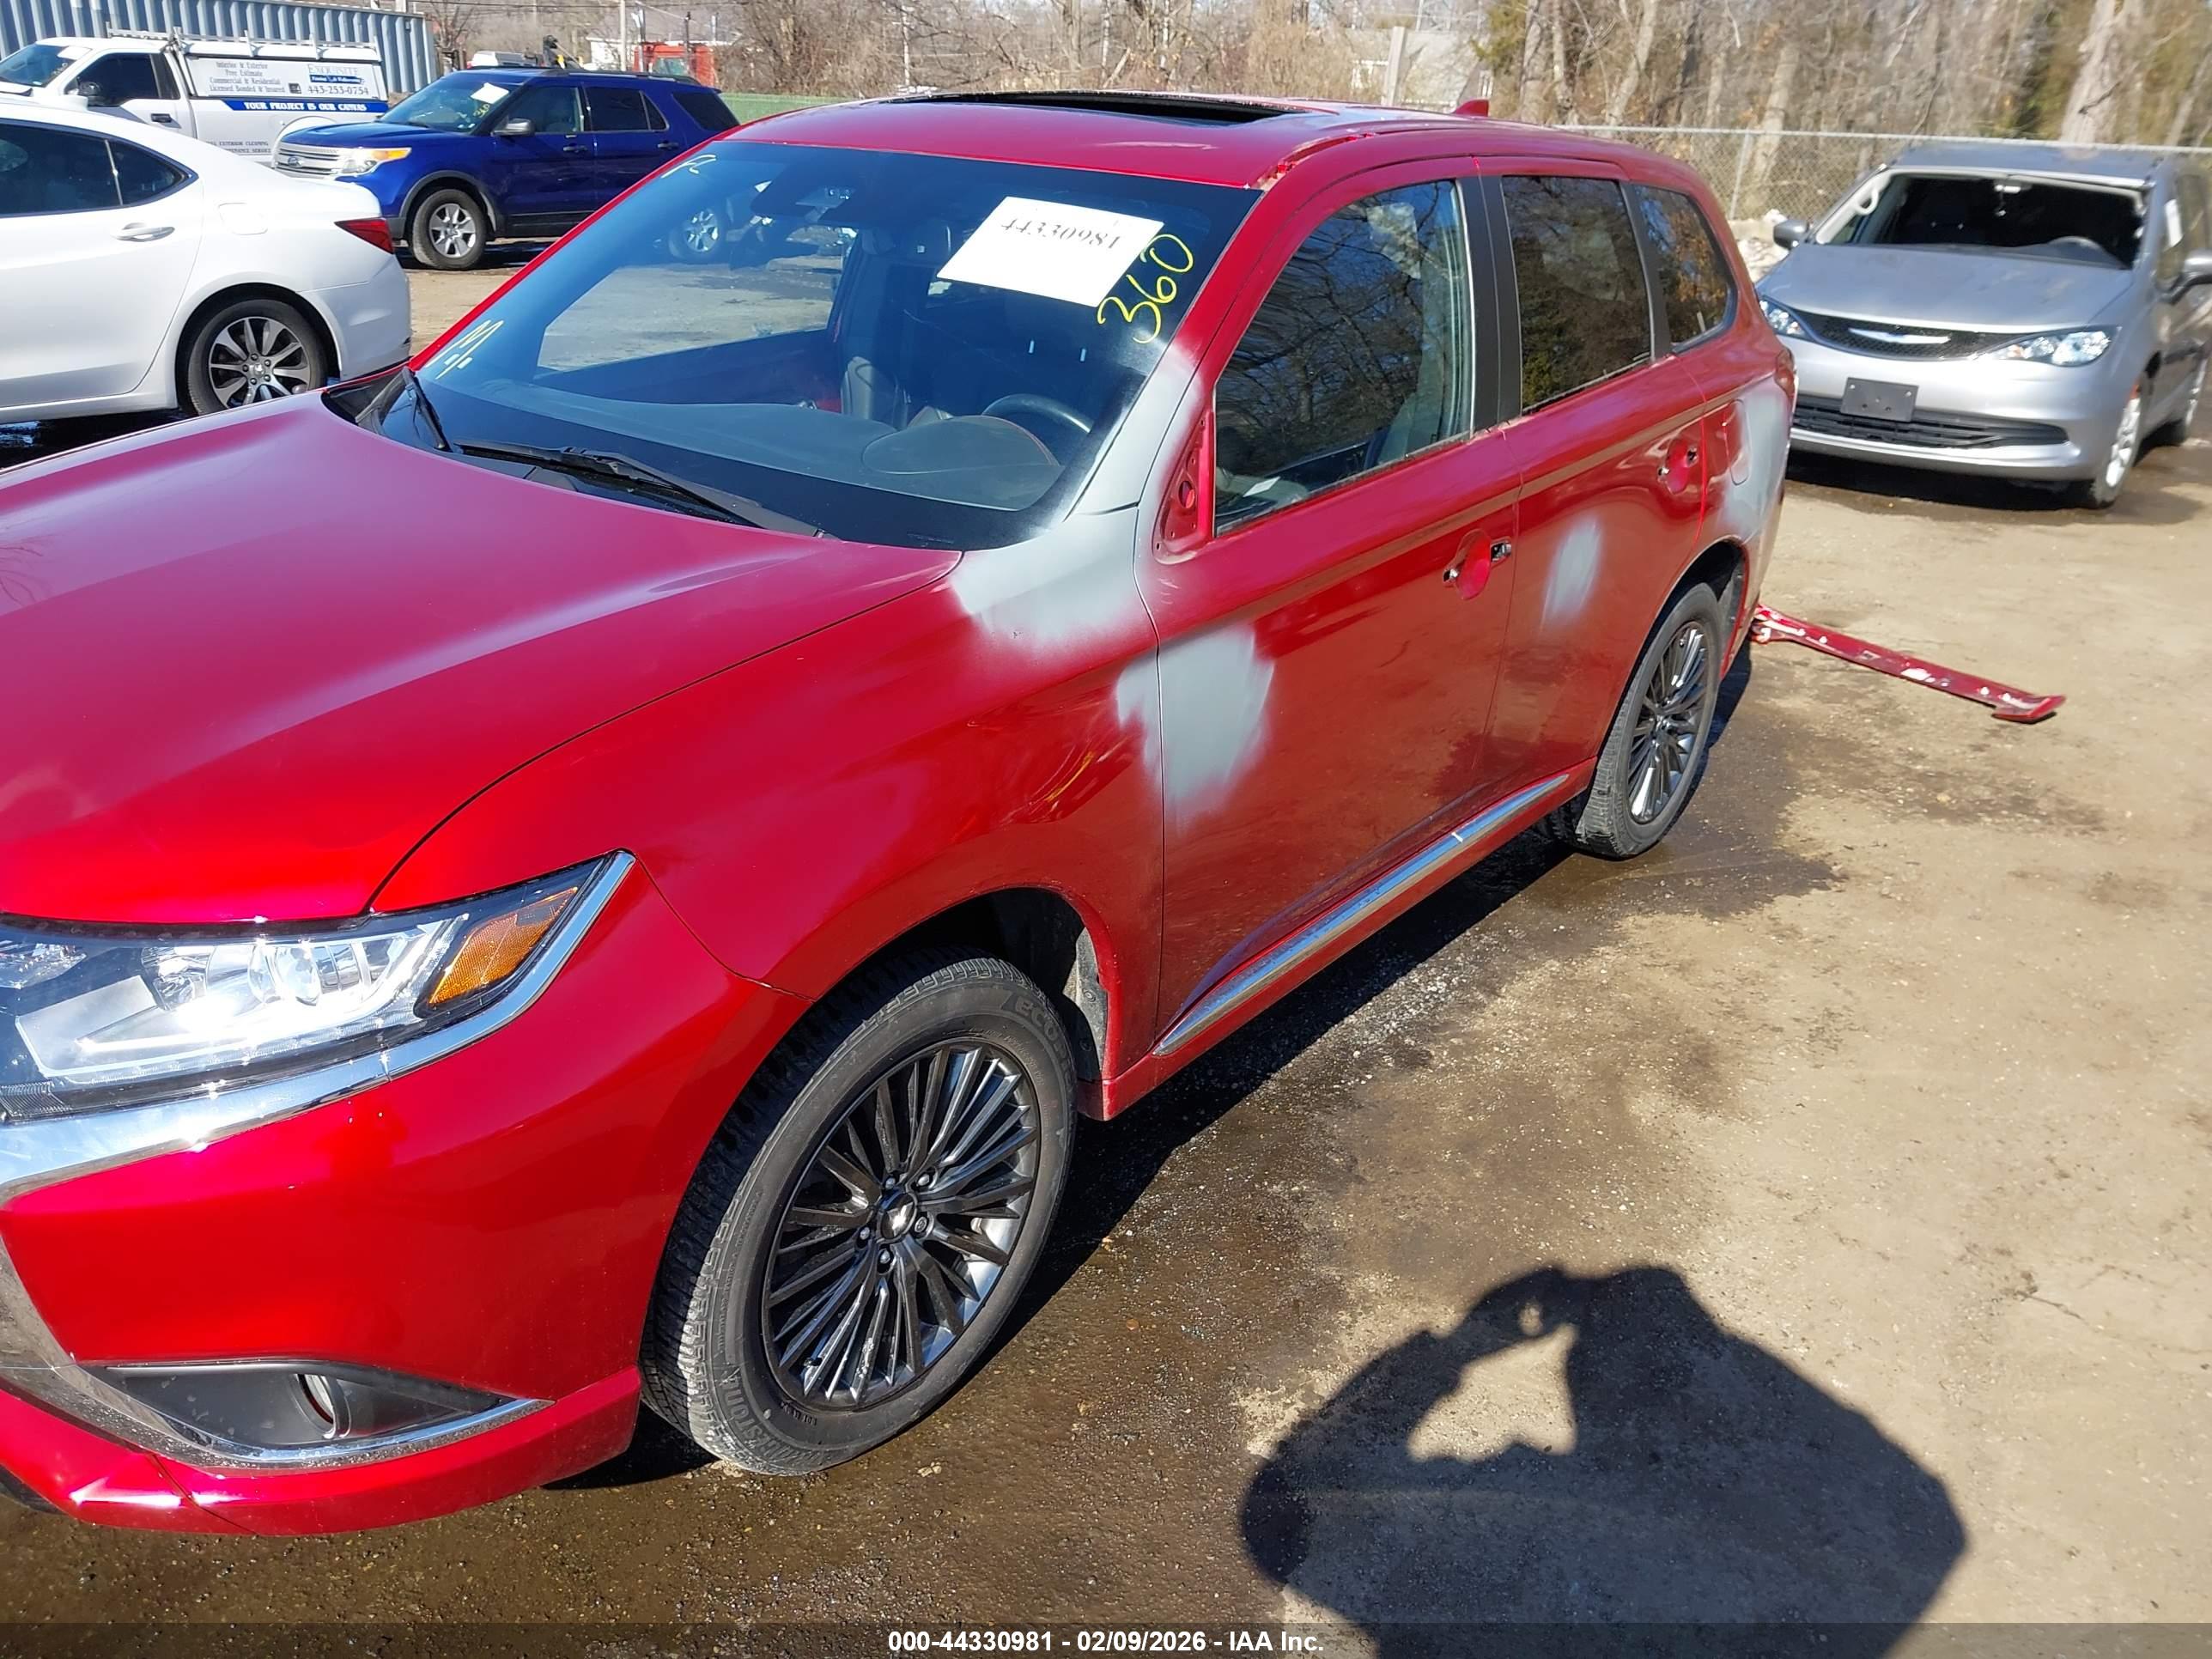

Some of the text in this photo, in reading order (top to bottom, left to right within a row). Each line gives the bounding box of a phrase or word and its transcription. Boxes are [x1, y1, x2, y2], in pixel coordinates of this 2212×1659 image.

[243, 101, 368, 112] YOUR PROJECT IS OUR CANVAS
[1000, 217, 1121, 250] 44330981
[1097, 234, 1194, 344] 360
